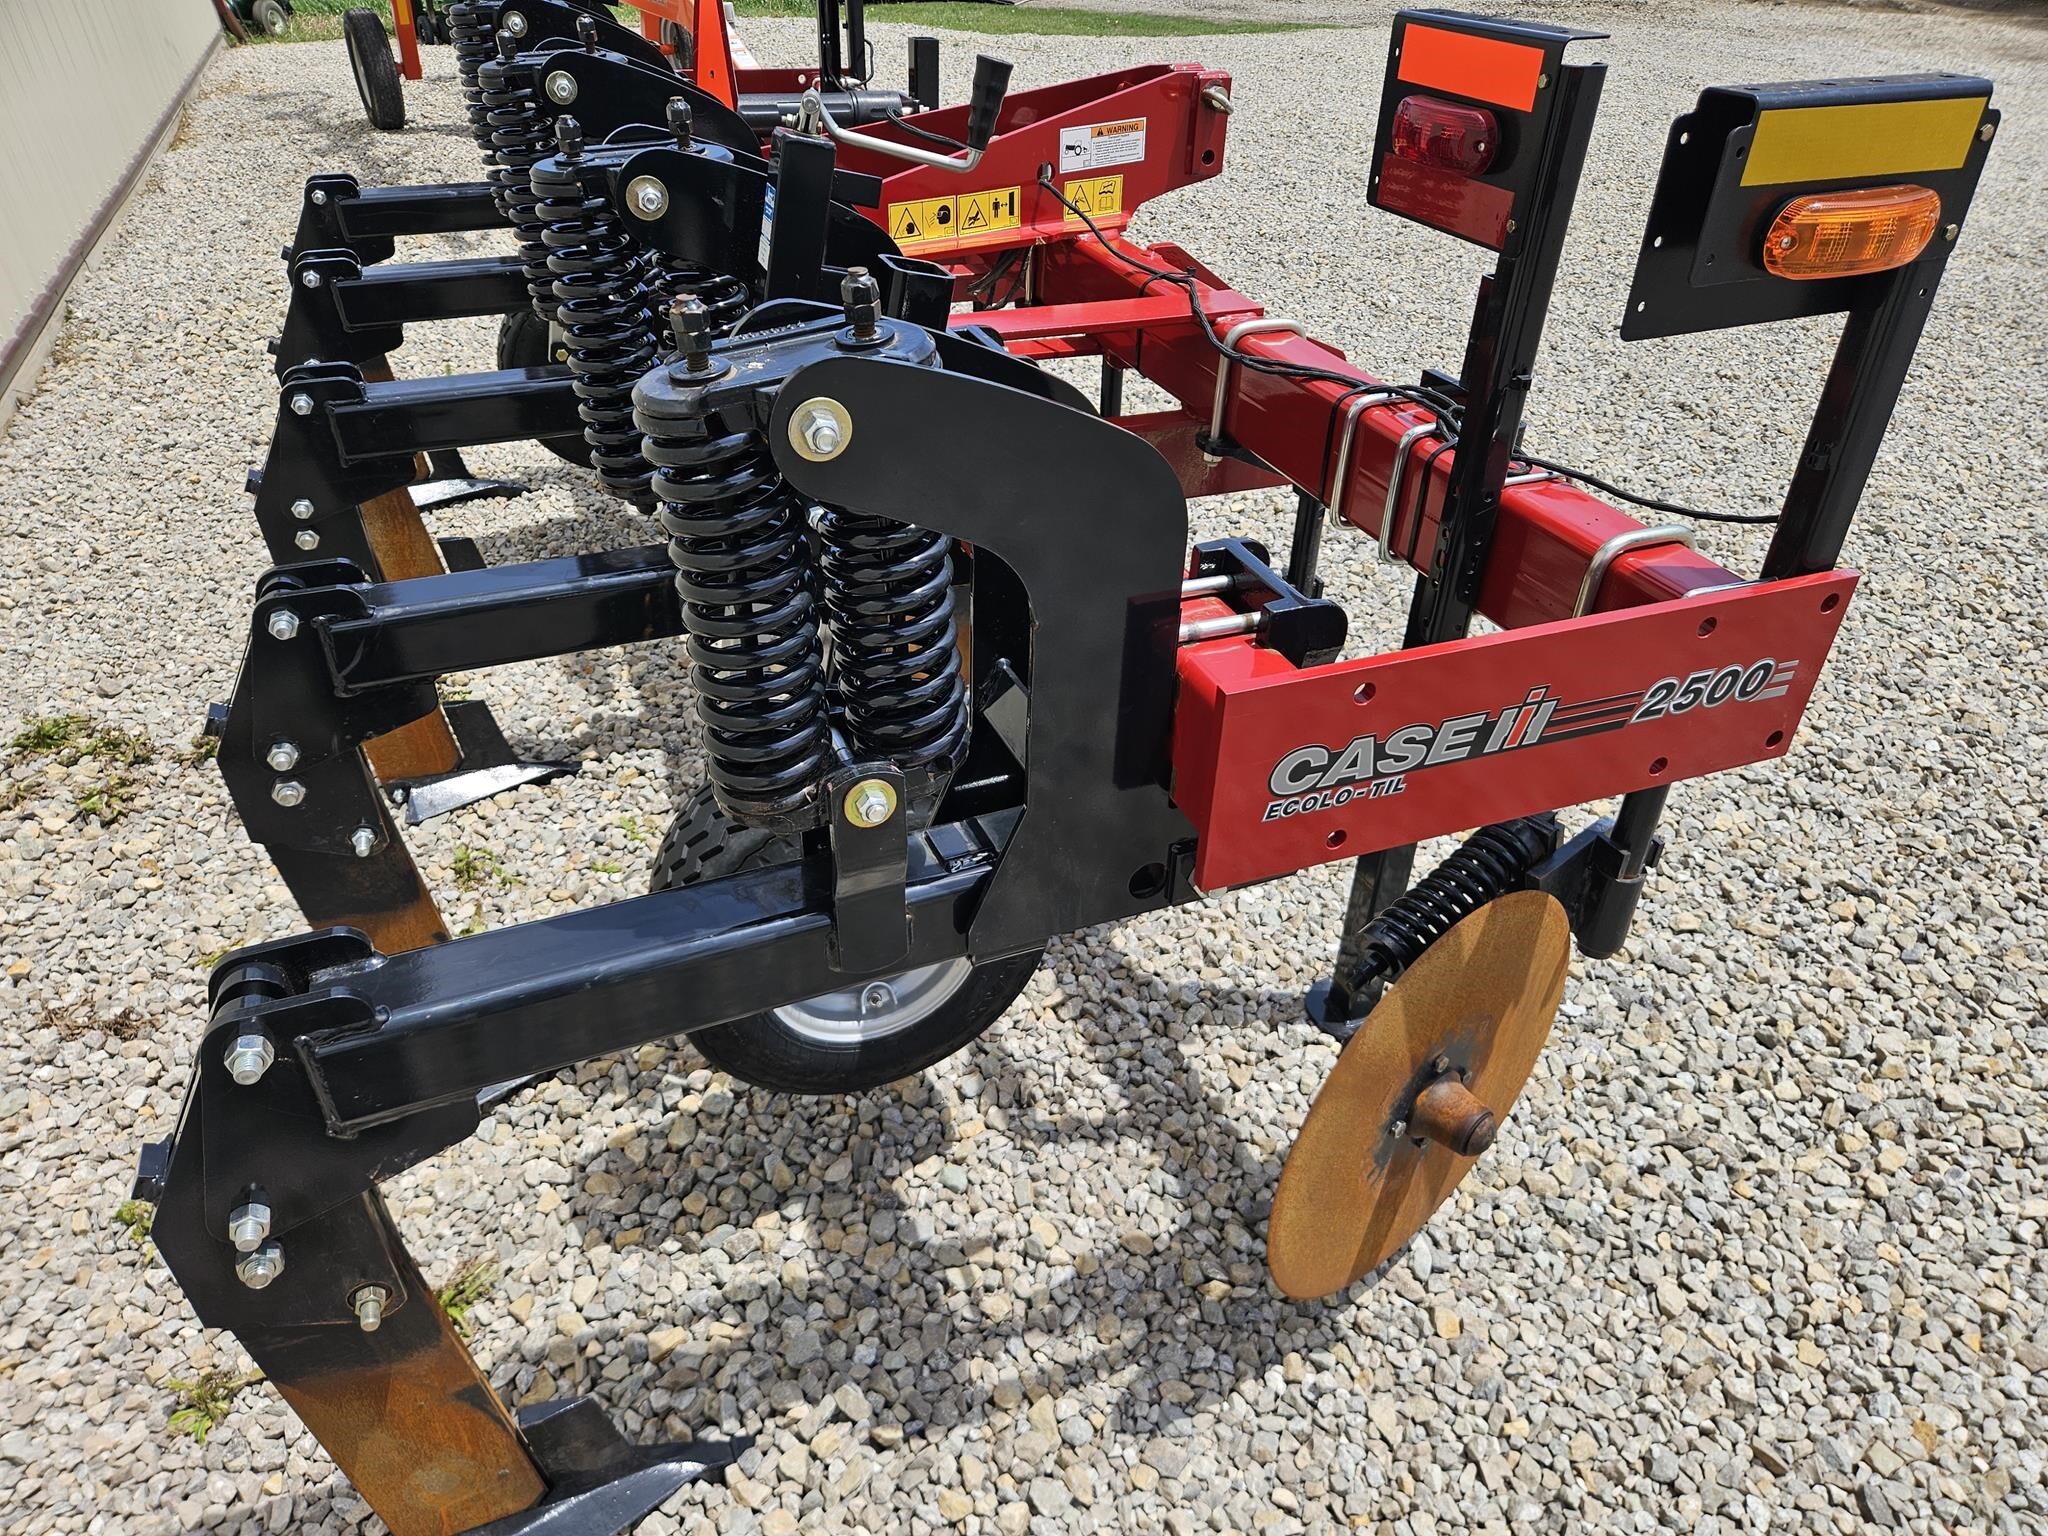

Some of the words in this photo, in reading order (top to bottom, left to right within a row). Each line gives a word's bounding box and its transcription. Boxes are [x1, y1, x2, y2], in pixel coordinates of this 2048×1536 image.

[1106, 123, 1139, 134] WARNING
[1269, 711, 1489, 796] CASE
[1630, 658, 1776, 723] 2500
[1262, 775, 1407, 821] ECOLO-TIL
